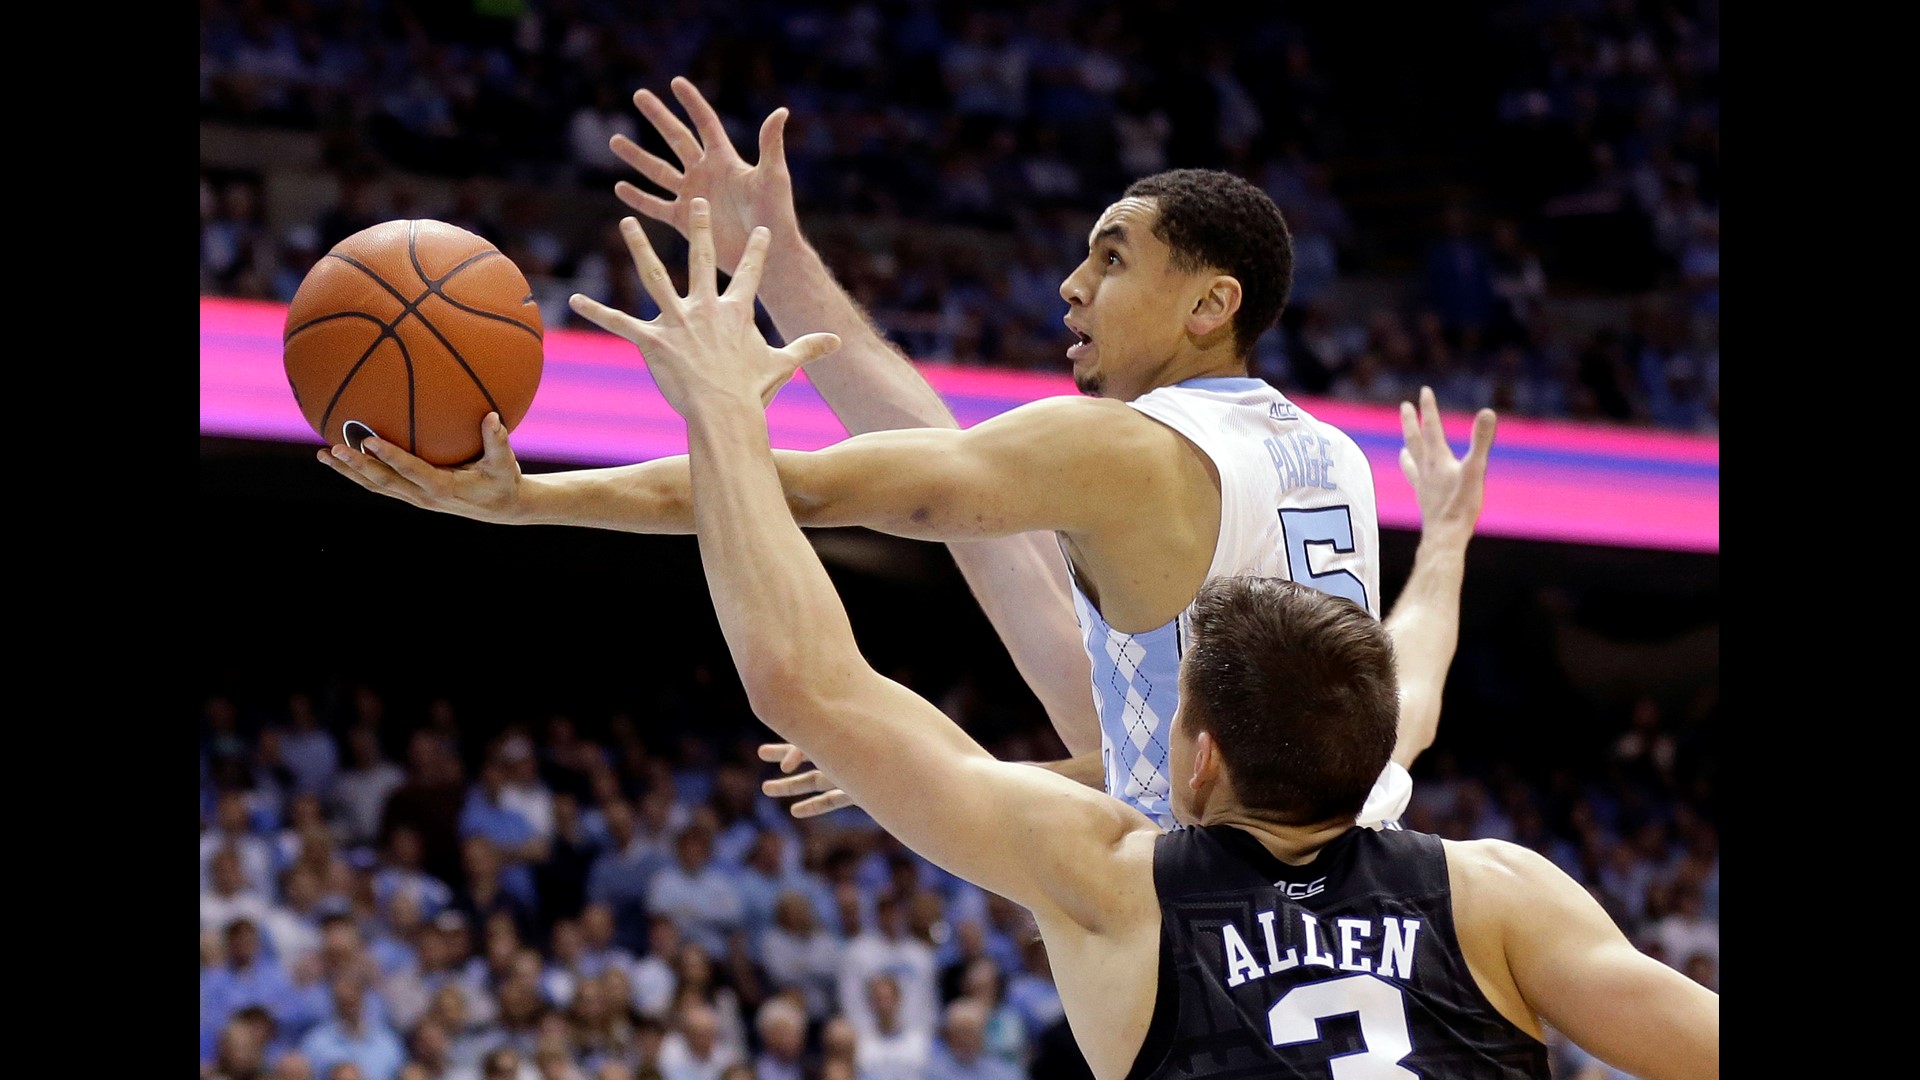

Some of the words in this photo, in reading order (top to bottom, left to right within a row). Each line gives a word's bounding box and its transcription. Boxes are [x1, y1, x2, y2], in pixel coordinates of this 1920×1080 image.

[1269, 401, 1298, 420] ACC
[1263, 431, 1337, 493] PAIGE
[1277, 504, 1370, 612] 5
[1221, 911, 1421, 988] ALLEN
[1266, 972, 1422, 1080] 3
